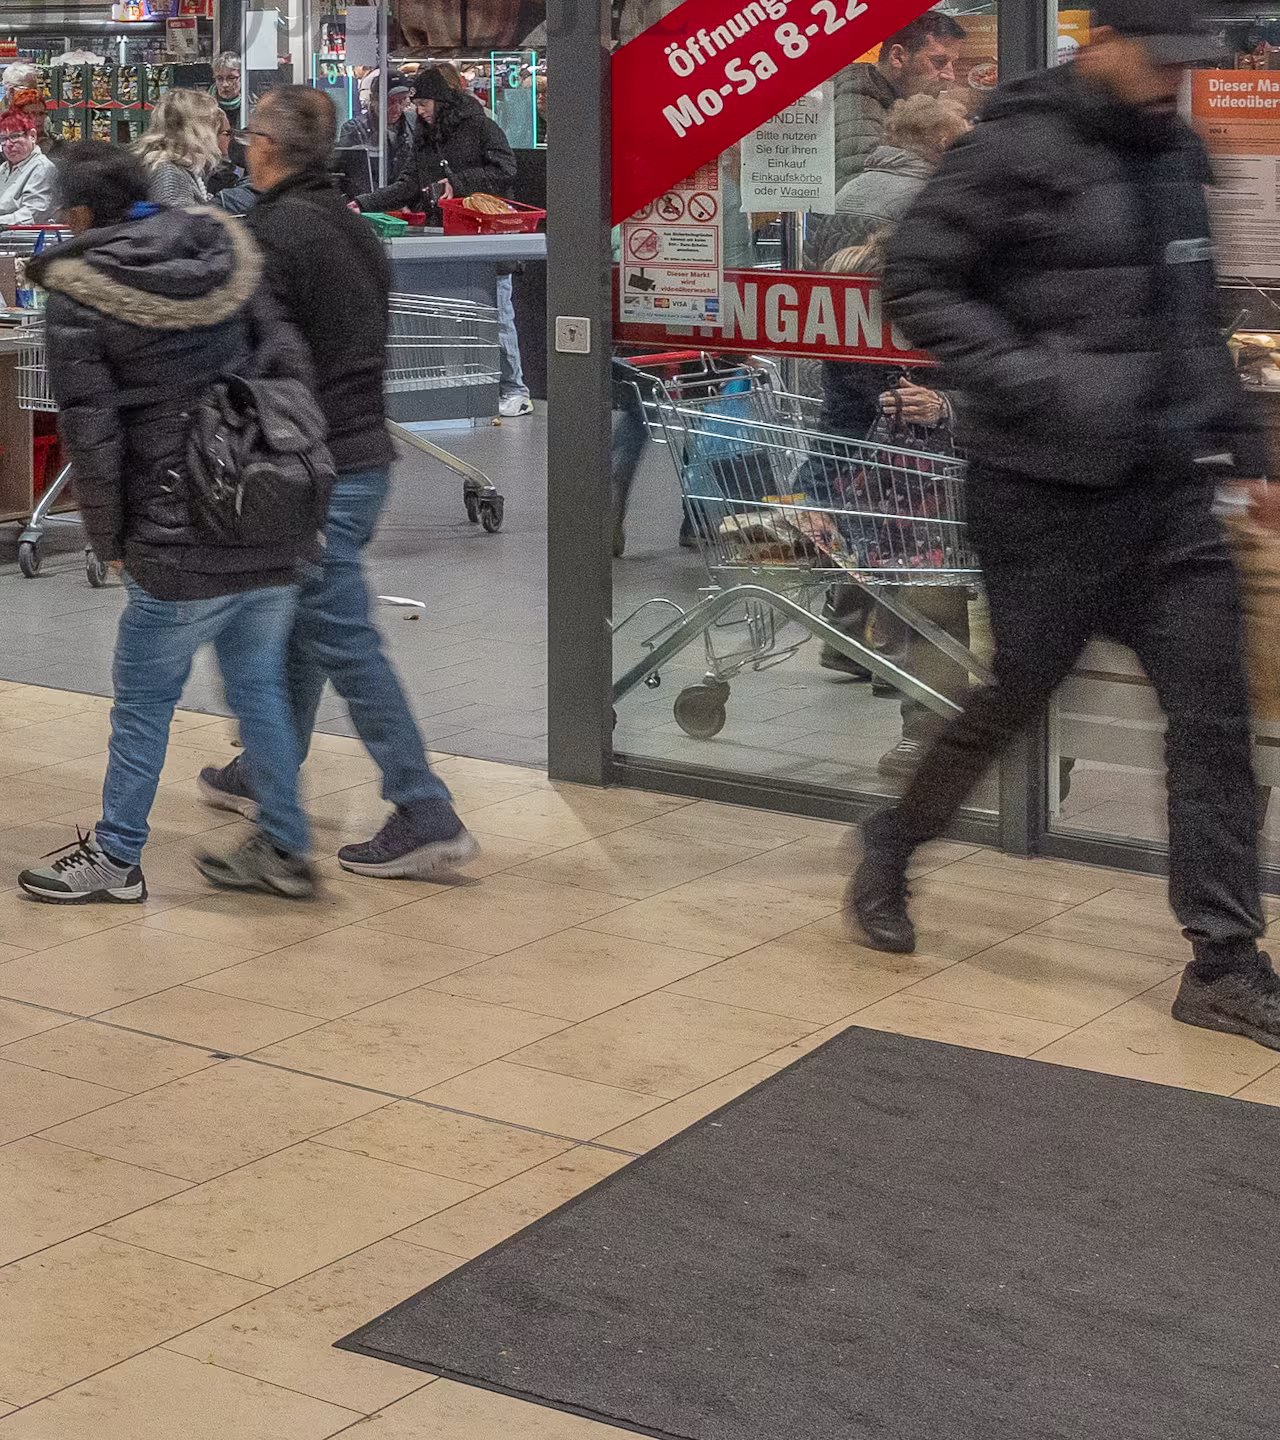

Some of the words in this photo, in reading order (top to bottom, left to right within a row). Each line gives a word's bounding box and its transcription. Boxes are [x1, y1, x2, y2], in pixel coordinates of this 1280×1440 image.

[1208, 79, 1254, 93] Dieser
[662, 50, 779, 138] Mo-Sa
[756, 130, 779, 141] Bitte
[782, 132, 817, 141] nutzen
[756, 144, 772, 155] Sie
[775, 144, 789, 155] für
[768, 158, 807, 169] Einkauf
[751, 171, 822, 183] Einkaufskörbe
[754, 186, 778, 196] oder
[780, 186, 820, 198] Wagen!
[690, 271, 710, 279] Markt
